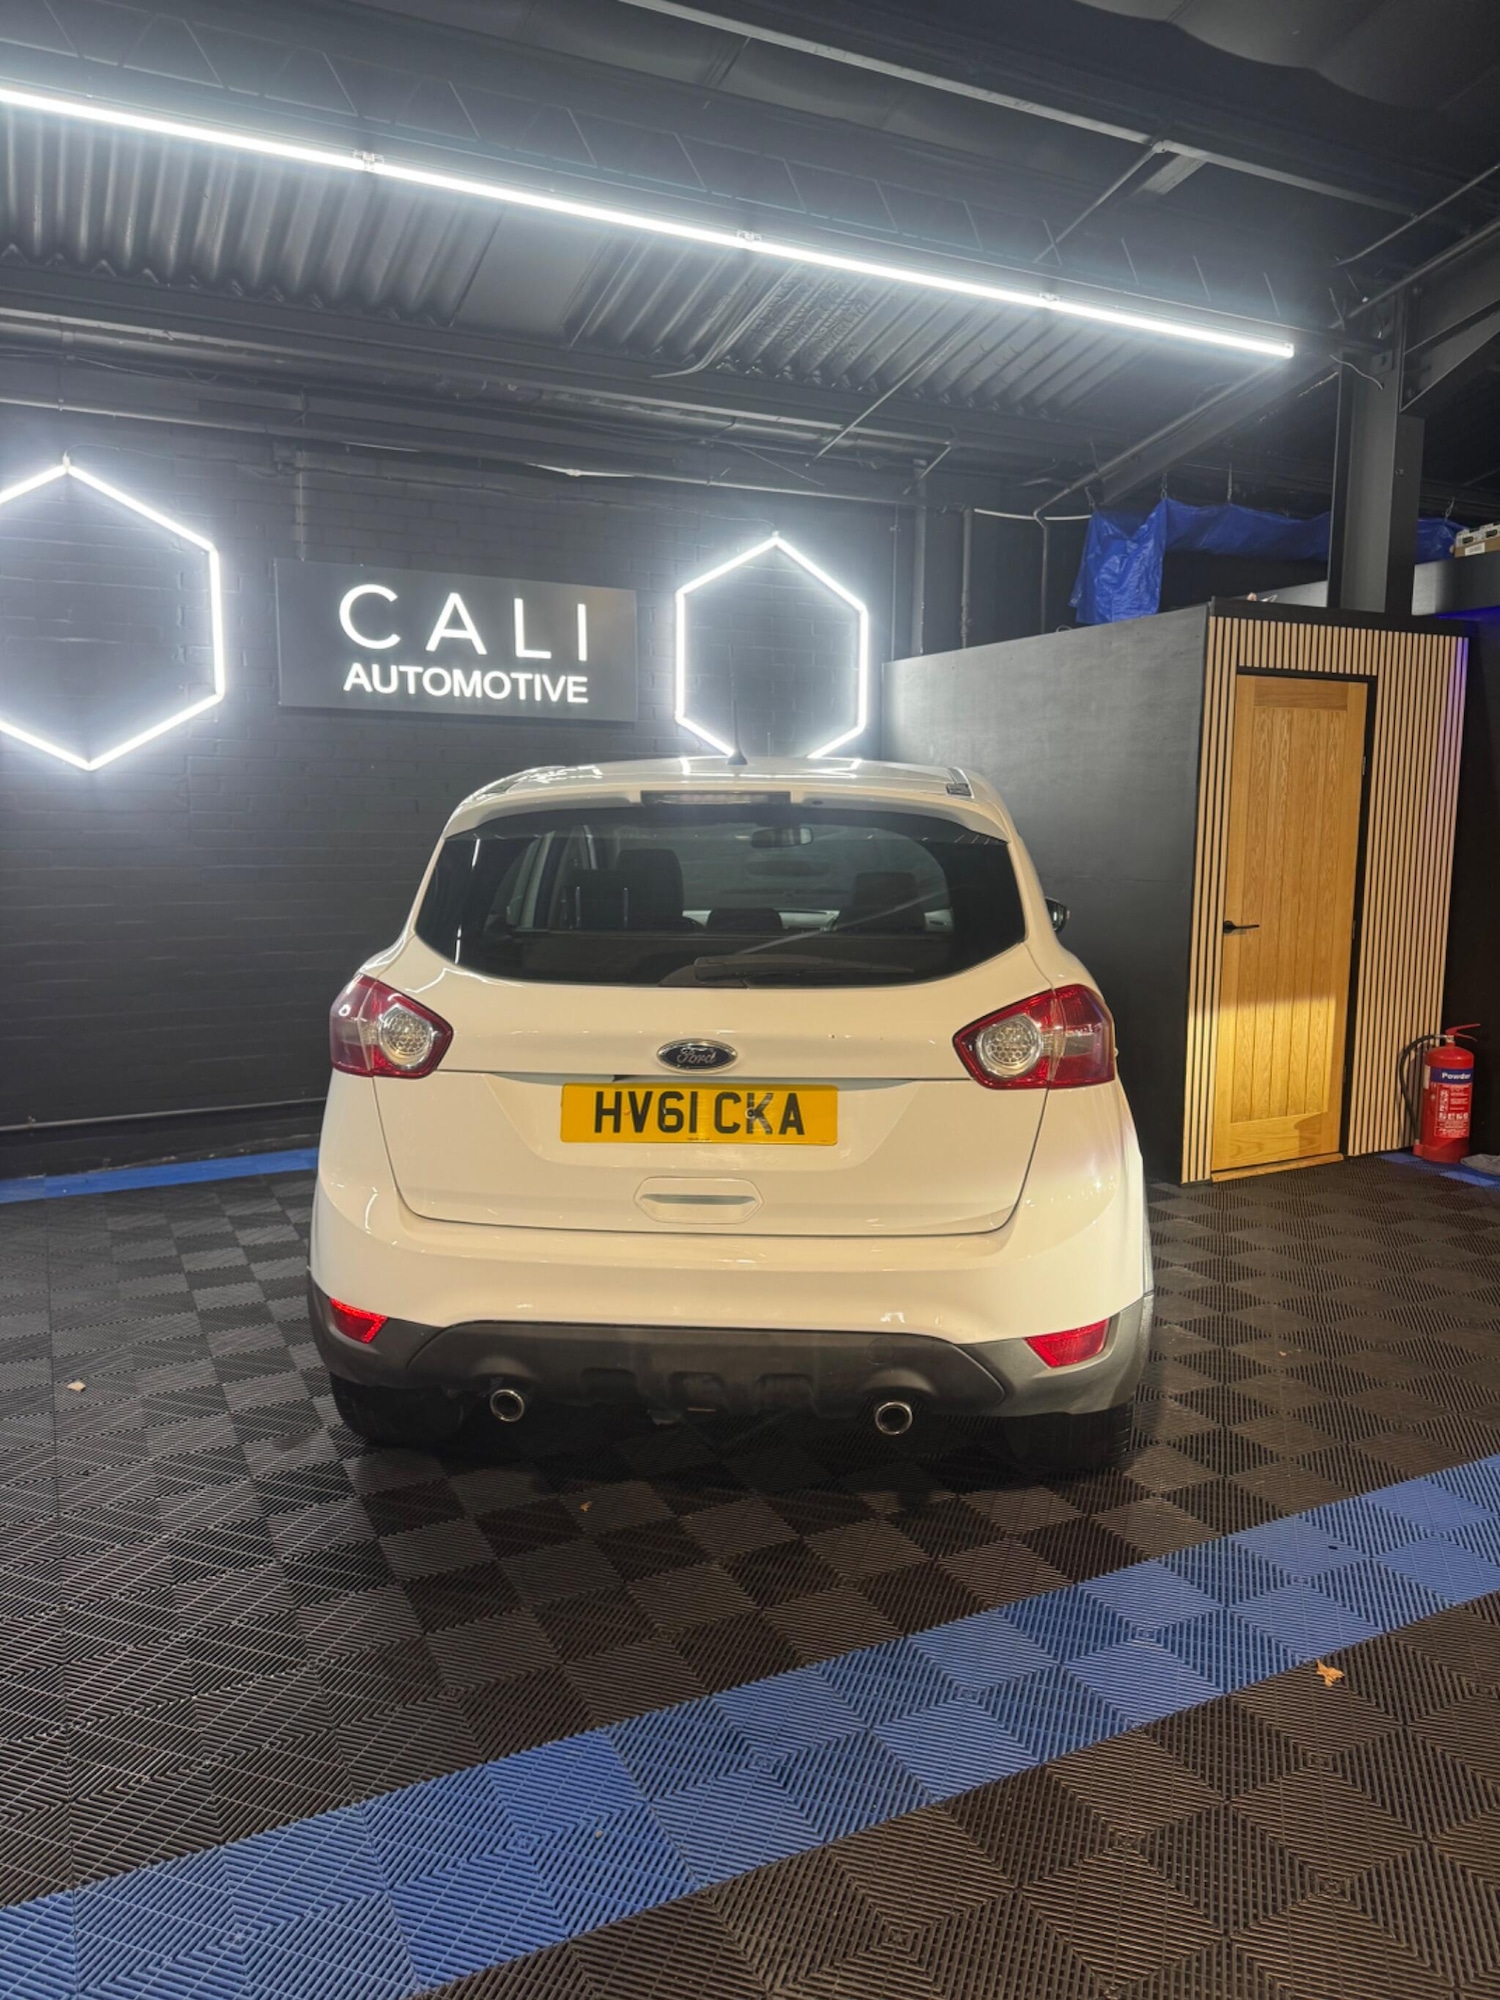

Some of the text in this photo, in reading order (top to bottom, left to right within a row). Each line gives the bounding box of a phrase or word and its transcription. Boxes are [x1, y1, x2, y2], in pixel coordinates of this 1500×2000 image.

[338, 583, 589, 662] CALI
[342, 662, 590, 704] AUTOMOTIVE
[676, 1046, 718, 1064] Ford
[594, 1091, 806, 1136] HV61 CKA
